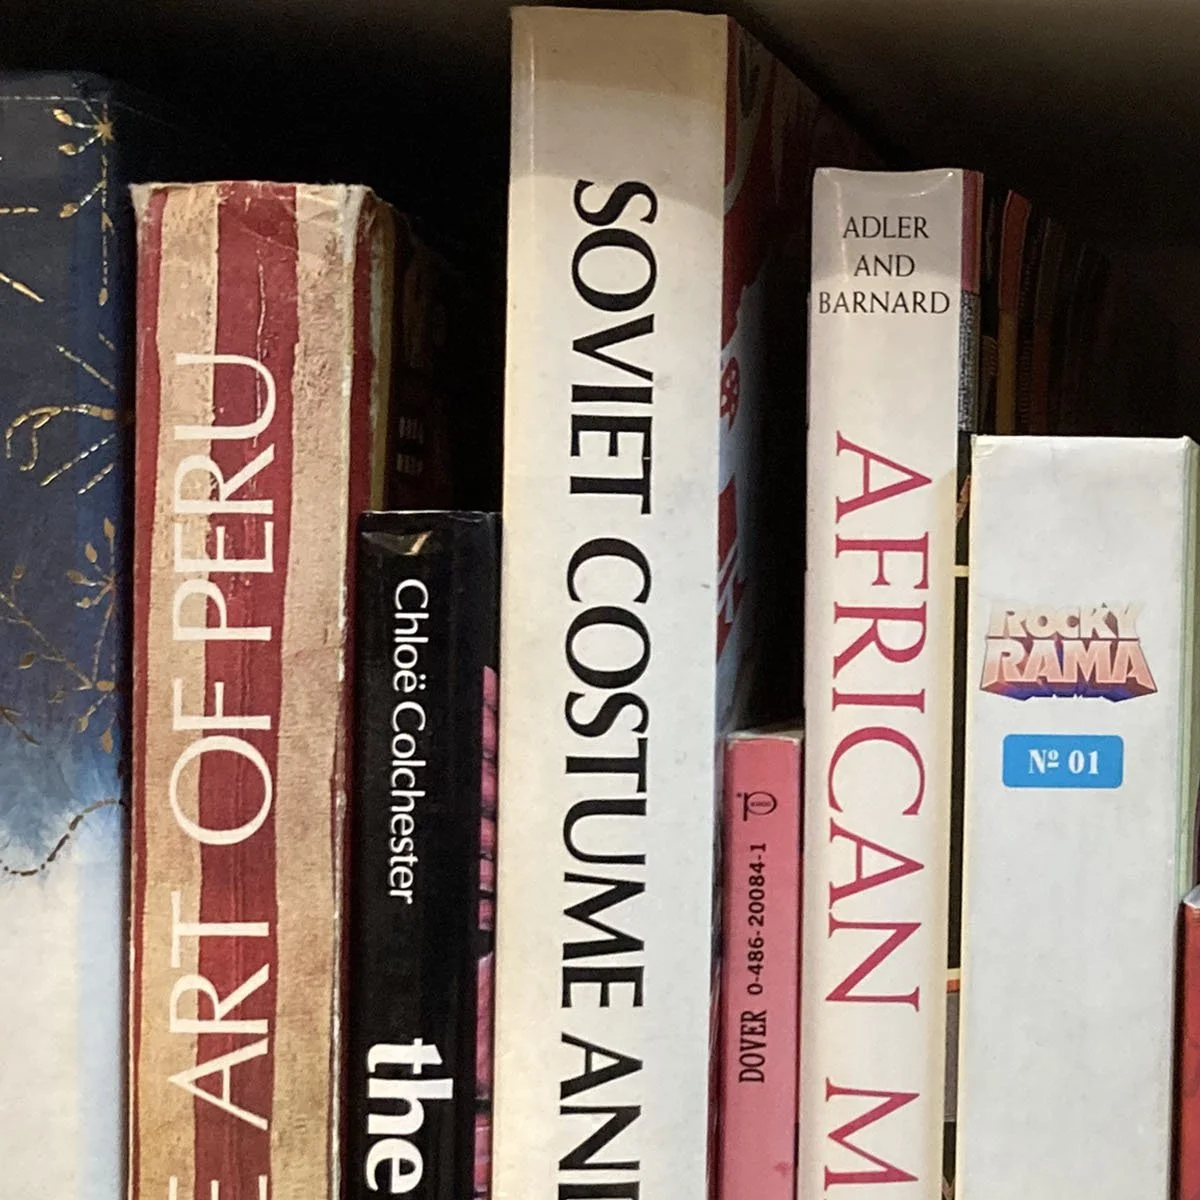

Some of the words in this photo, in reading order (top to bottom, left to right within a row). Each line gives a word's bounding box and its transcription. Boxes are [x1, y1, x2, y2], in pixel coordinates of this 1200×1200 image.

[818, 292, 950, 314] BARNARD
[842, 216, 929, 239] ADLER
[853, 254, 915, 278] AND
[570, 179, 658, 514] SOVIET
[173, 353, 276, 643] PERU
[393, 578, 429, 691] Chloë
[980, 638, 1157, 695] RAMA
[986, 602, 1146, 638] ROCKY
[169, 678, 273, 845] OF
[560, 537, 652, 1009] COSTUME
[825, 430, 932, 1011] AFRICAN
[1068, 750, 1099, 775] 01
[388, 699, 428, 904] Colchester
[748, 843, 767, 995] 0-486-20084-1
[168, 890, 270, 1130] ART
[738, 1009, 766, 1084] DOVER
[366, 1037, 453, 1193] the
